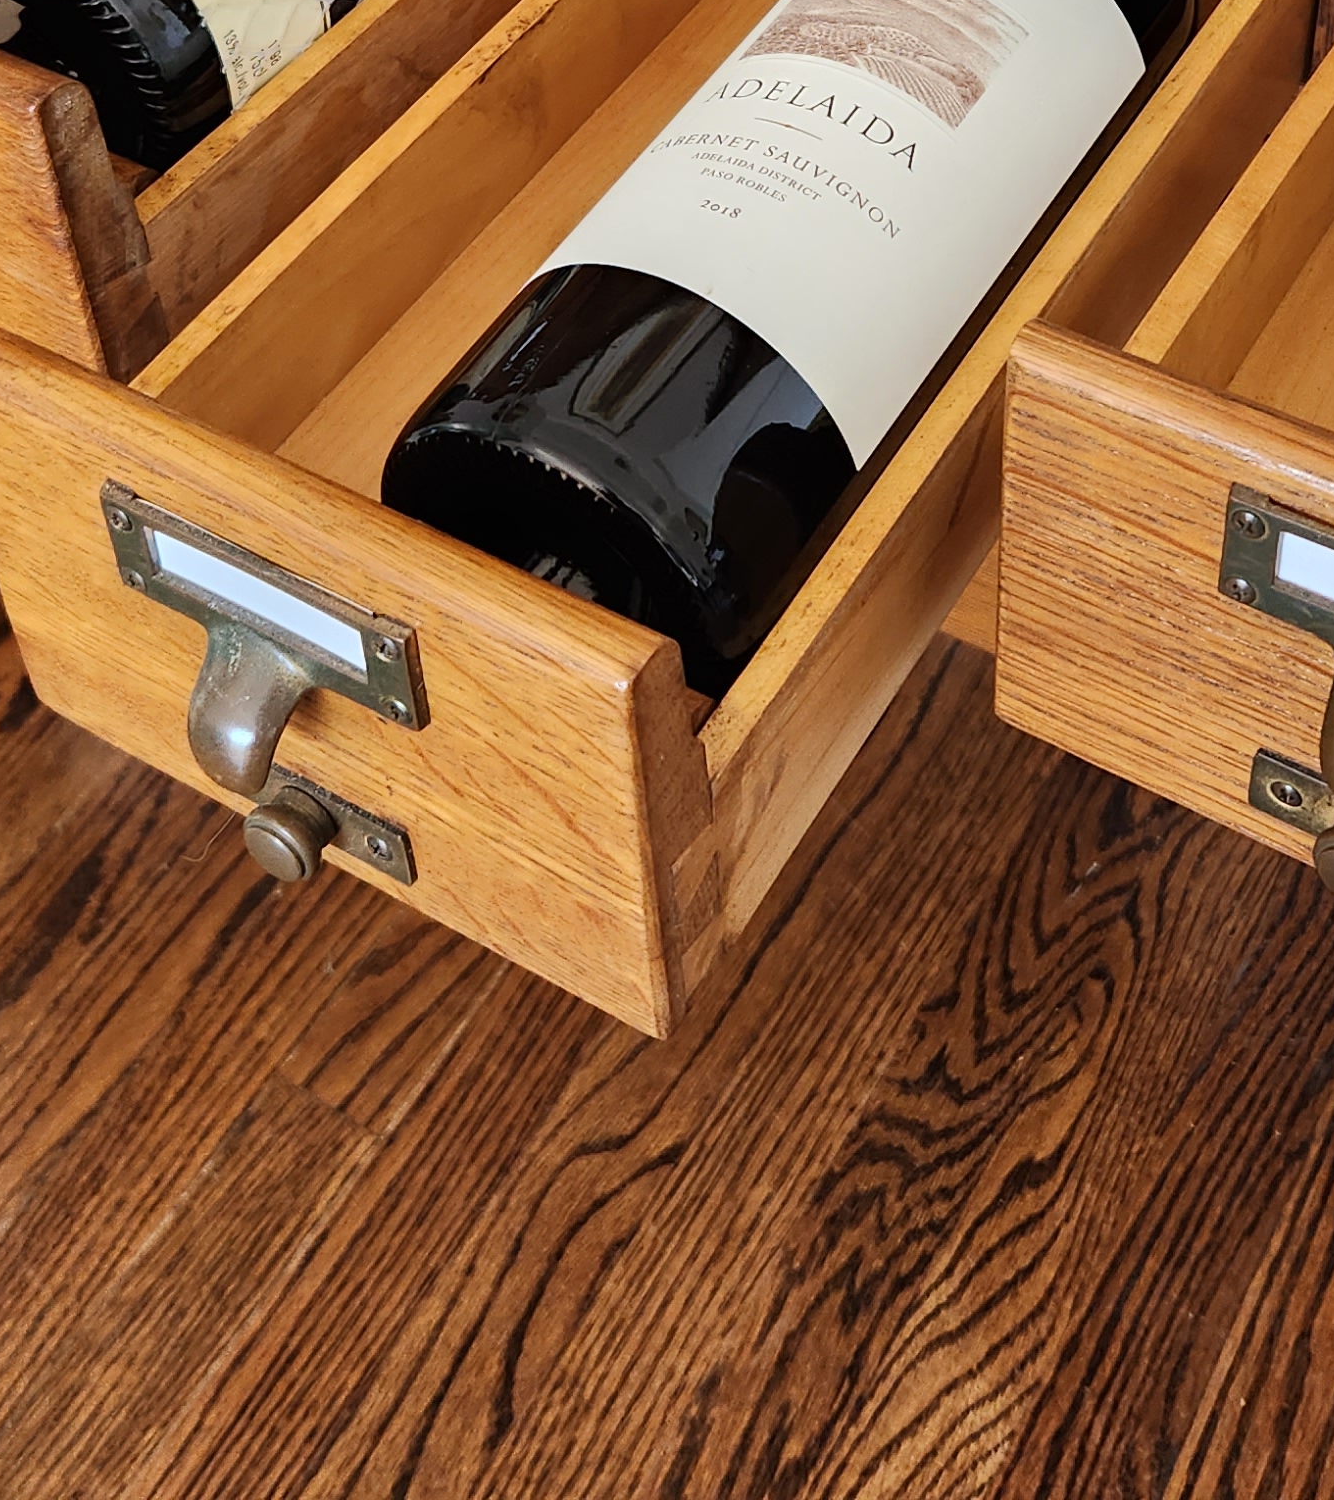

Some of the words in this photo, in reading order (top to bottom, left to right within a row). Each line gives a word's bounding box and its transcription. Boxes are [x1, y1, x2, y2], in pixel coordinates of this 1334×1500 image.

[703, 77, 915, 173] ADELAIDA
[650, 133, 760, 154] CABERNET
[762, 145, 901, 239] SAUVIGNON
[691, 151, 755, 172] ADELAIDA
[758, 165, 822, 201] DISTRICT
[700, 167, 734, 181] PASO
[735, 175, 788, 203] ROBLES
[699, 199, 742, 219] 2018
